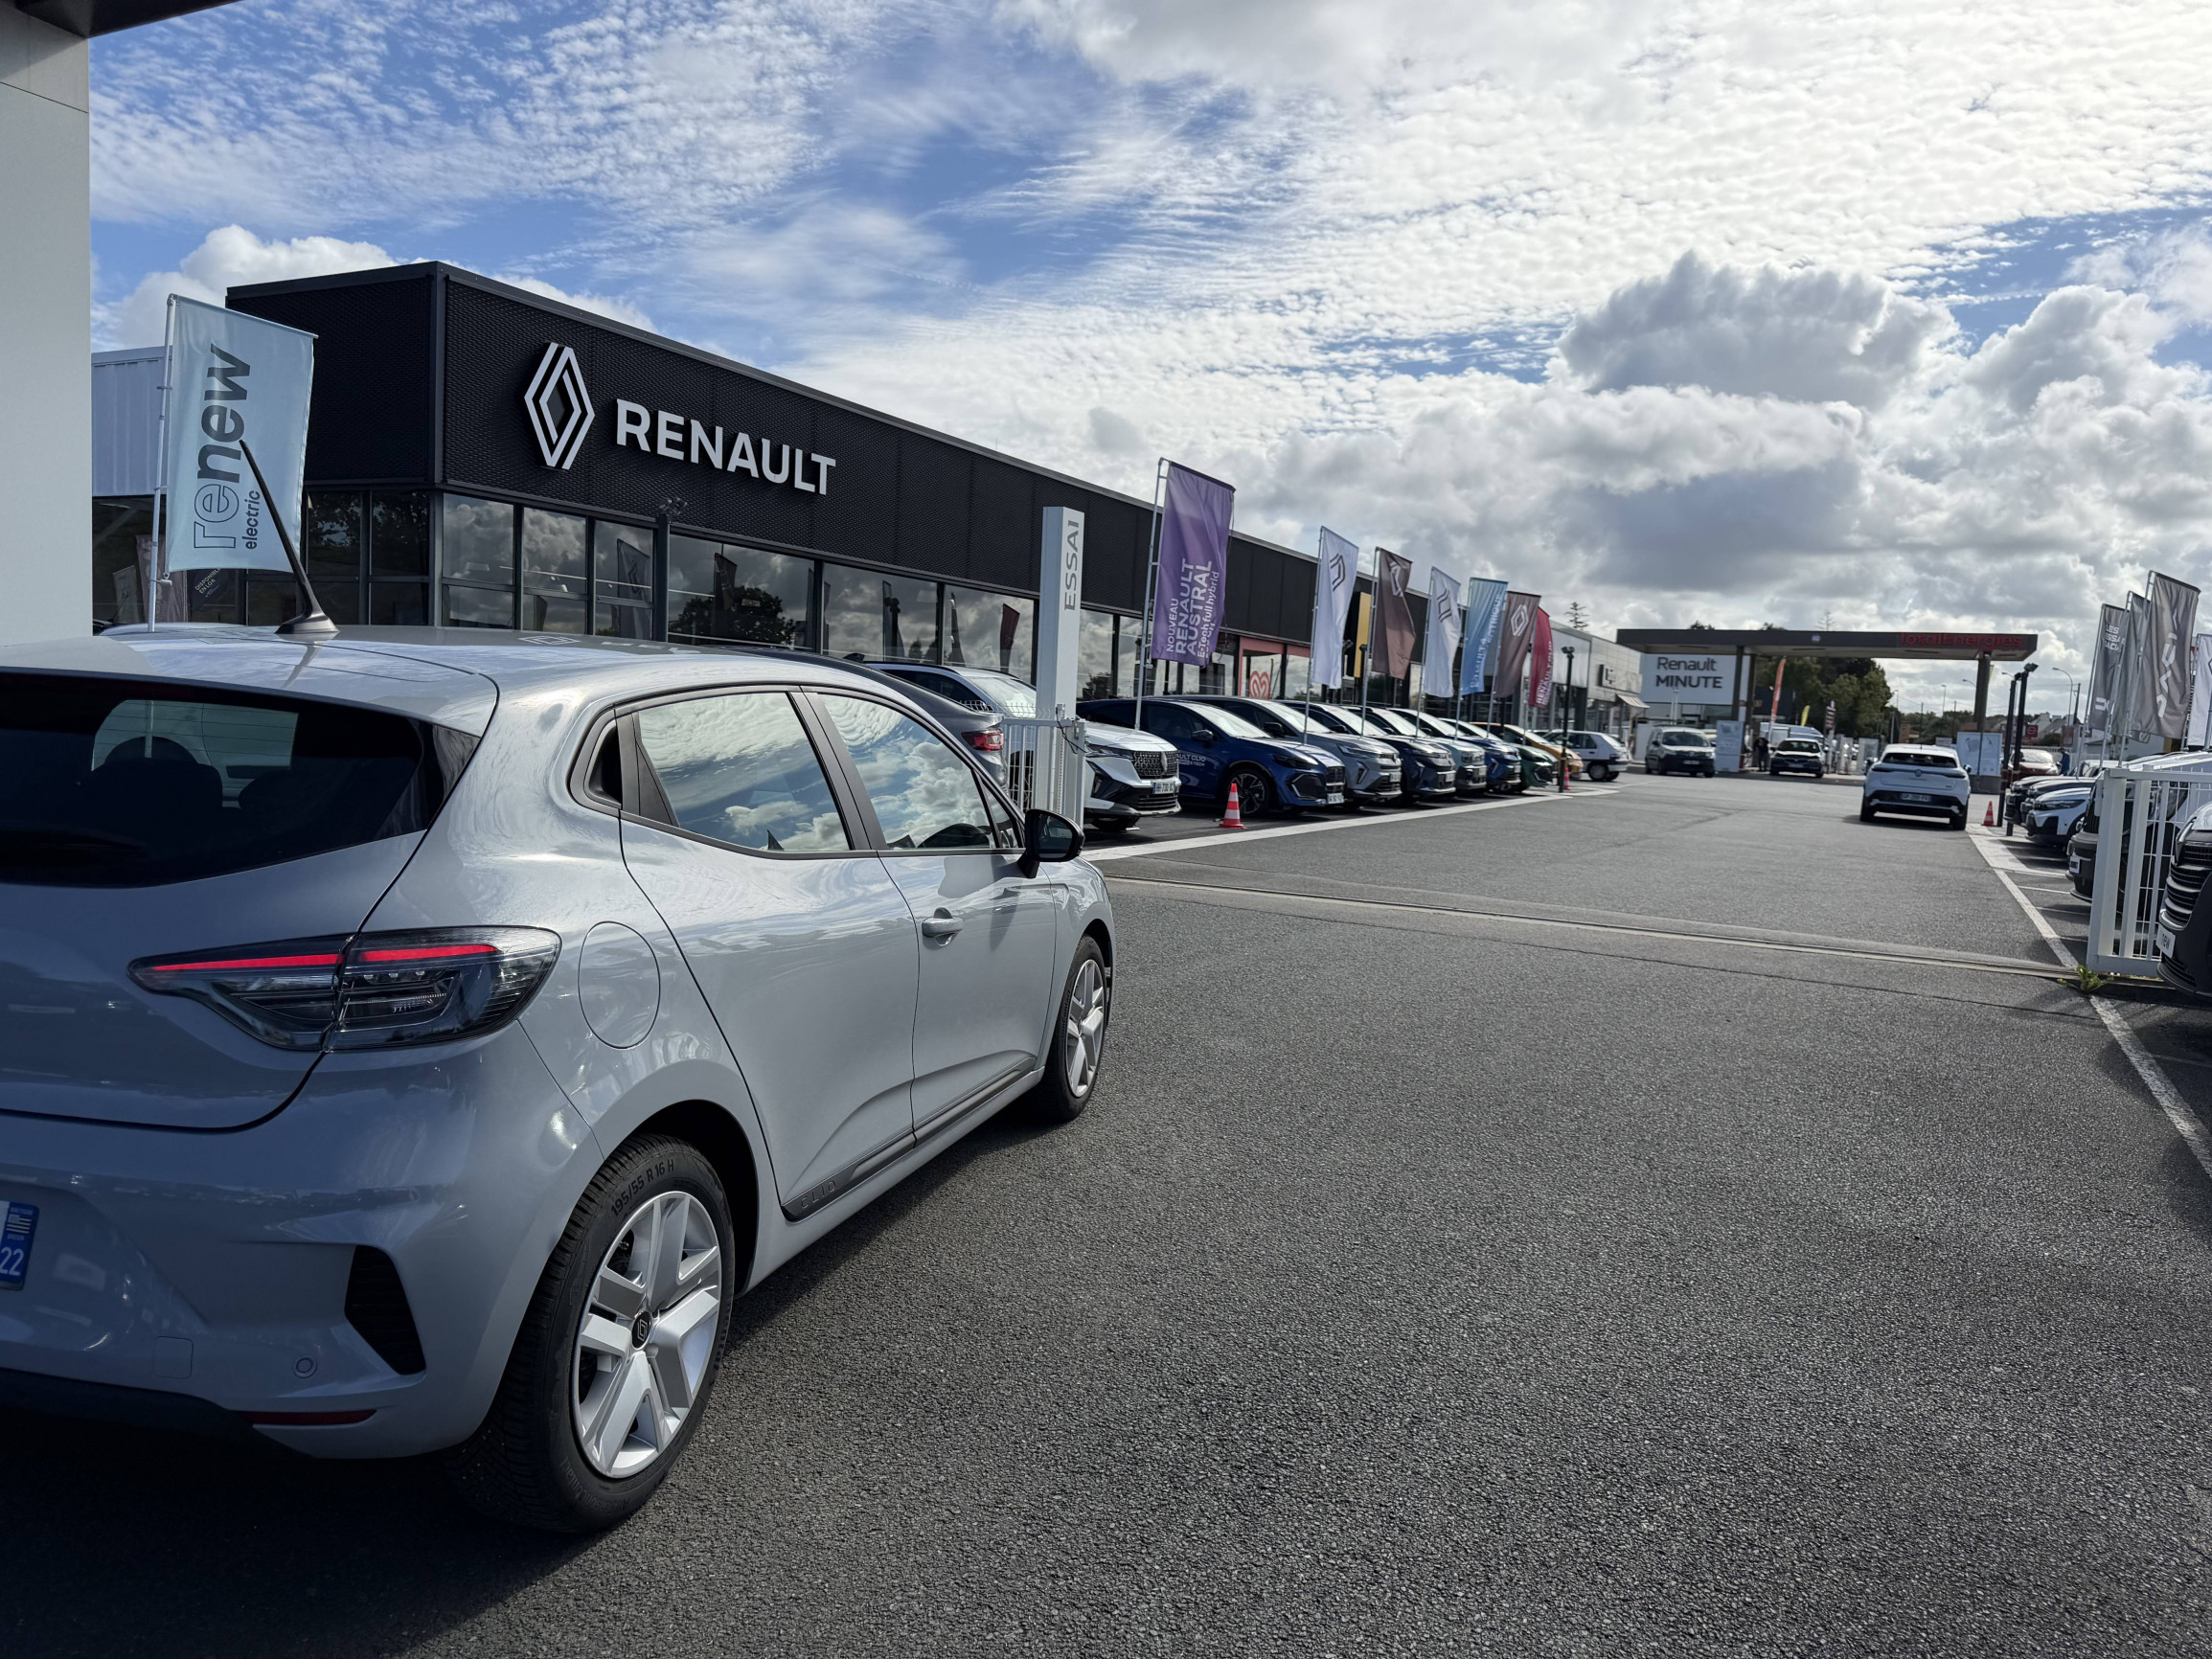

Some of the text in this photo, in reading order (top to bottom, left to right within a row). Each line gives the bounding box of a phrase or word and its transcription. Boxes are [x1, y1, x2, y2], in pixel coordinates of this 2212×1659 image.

[194, 343, 250, 549] renew
[616, 398, 836, 495] RENAULT
[241, 489, 261, 550] electric
[1063, 520, 1080, 611] ESSAI
[1207, 571, 1220, 605] hybrid
[1166, 598, 1179, 652] NOUVEAU
[1175, 558, 1194, 654] RENAULT
[1186, 560, 1213, 656] AUSTRAL
[1202, 604, 1213, 623] full
[1655, 674, 1724, 689] MINUTE
[1656, 656, 1718, 671] Renault
[611, 1158, 674, 1216] 195/55 R 16 H
[801, 1180, 836, 1209] CLIO
[0, 1246, 24, 1276] 22
